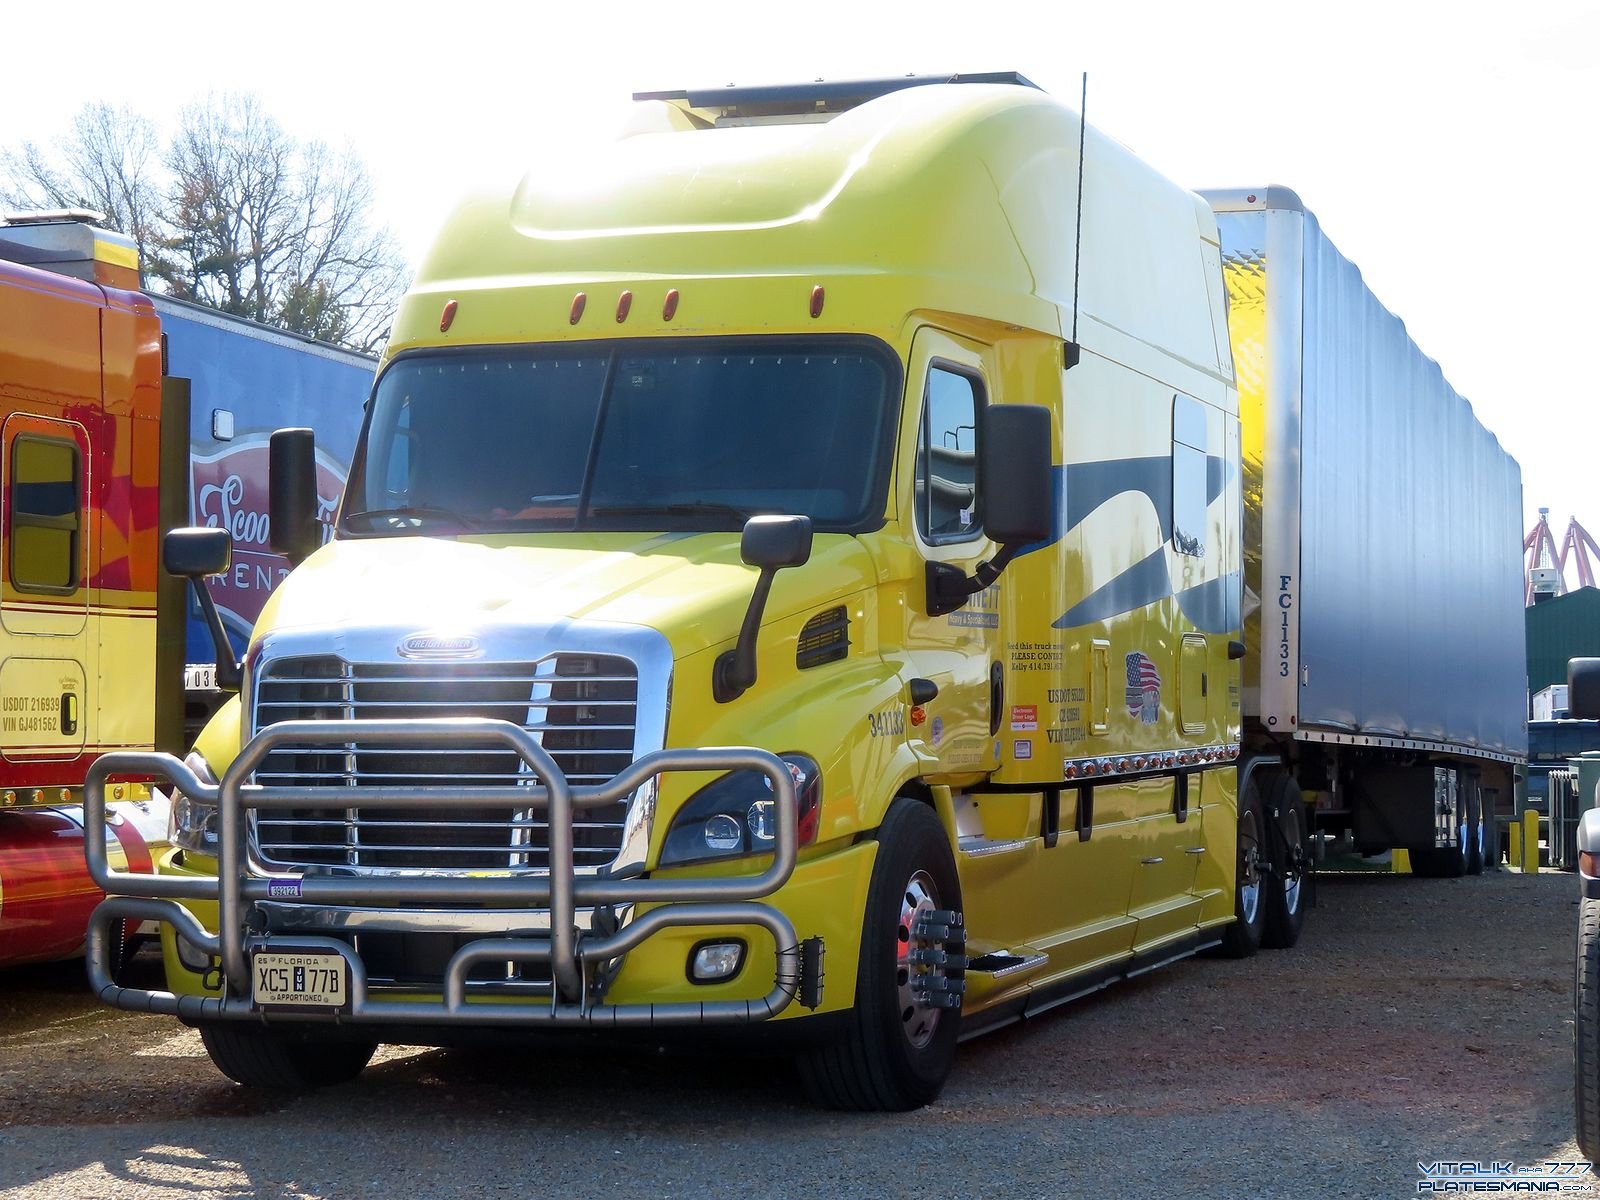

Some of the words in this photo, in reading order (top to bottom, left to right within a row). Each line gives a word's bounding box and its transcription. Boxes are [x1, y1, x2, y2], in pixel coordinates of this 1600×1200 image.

[200, 474, 270, 545] Scoo
[1278, 575, 1292, 677] FC1133
[1020, 642, 1033, 650] this
[1034, 642, 1051, 650] truck
[1011, 652, 1036, 661] PLEASE
[1011, 662, 1028, 673] Kelly
[1048, 688, 1071, 703] USDOT
[3, 697, 29, 711] USDOT
[31, 697, 60, 711] 216939
[3, 717, 17, 731] VIN
[19, 717, 57, 731] GJ481562
[868, 712, 904, 737] 341133
[278, 957, 320, 965] FLORIDA
[259, 968, 289, 992] XC5
[309, 969, 339, 993] 77B
[276, 993, 322, 1001] APPORTIONED
